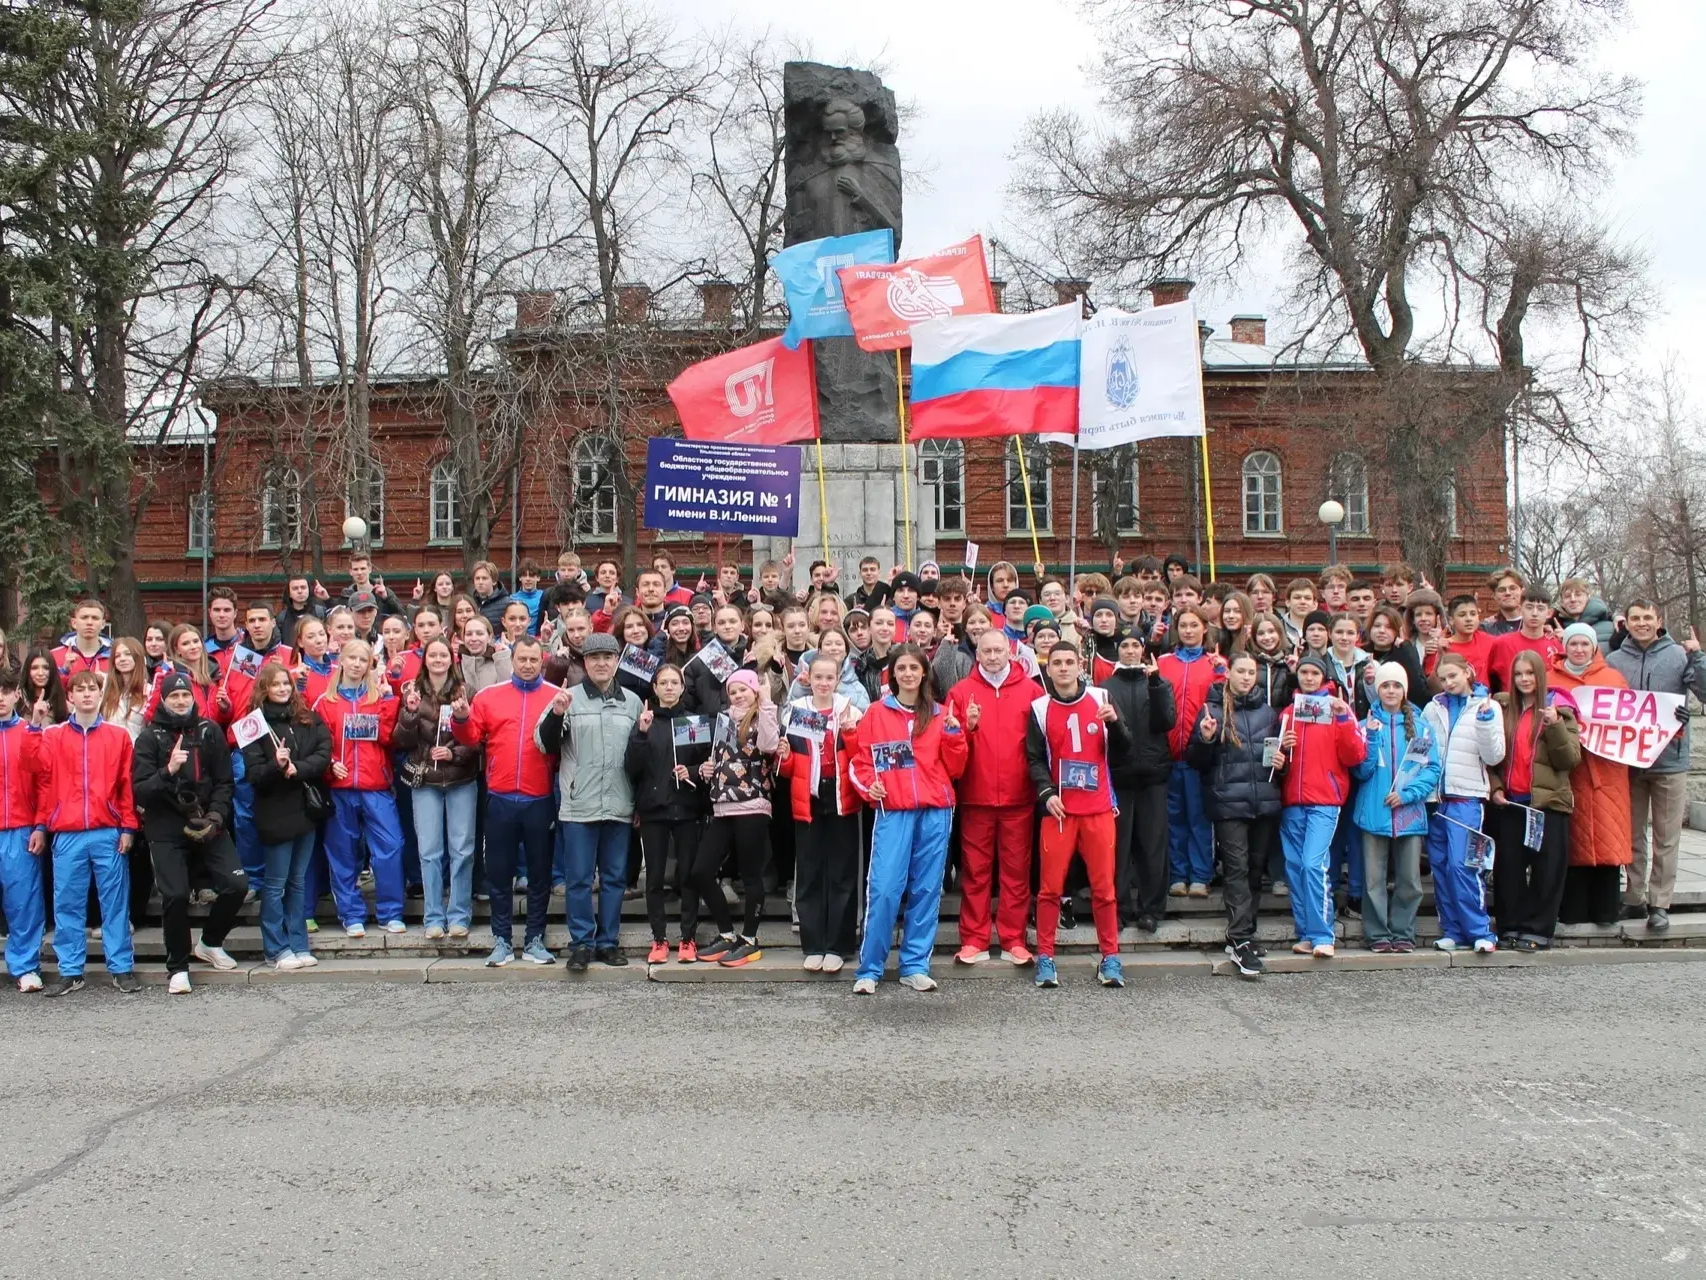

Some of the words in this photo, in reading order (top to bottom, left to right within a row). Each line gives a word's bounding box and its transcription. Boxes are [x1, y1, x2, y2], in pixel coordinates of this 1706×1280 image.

[659, 461, 702, 471] бюджетное
[705, 465, 789, 476] общеобразовательное
[672, 454, 713, 465] Областное
[714, 459, 777, 469] государственное
[701, 473, 747, 482] учреждение
[654, 485, 754, 507] ГИМНАЗИЯ
[760, 491, 779, 508] №
[784, 493, 792, 509] 1
[668, 508, 706, 520] имени
[709, 510, 778, 524] В.И.Ленина
[1591, 688, 1661, 731] ЕВА,
[1067, 712, 1082, 753] 1
